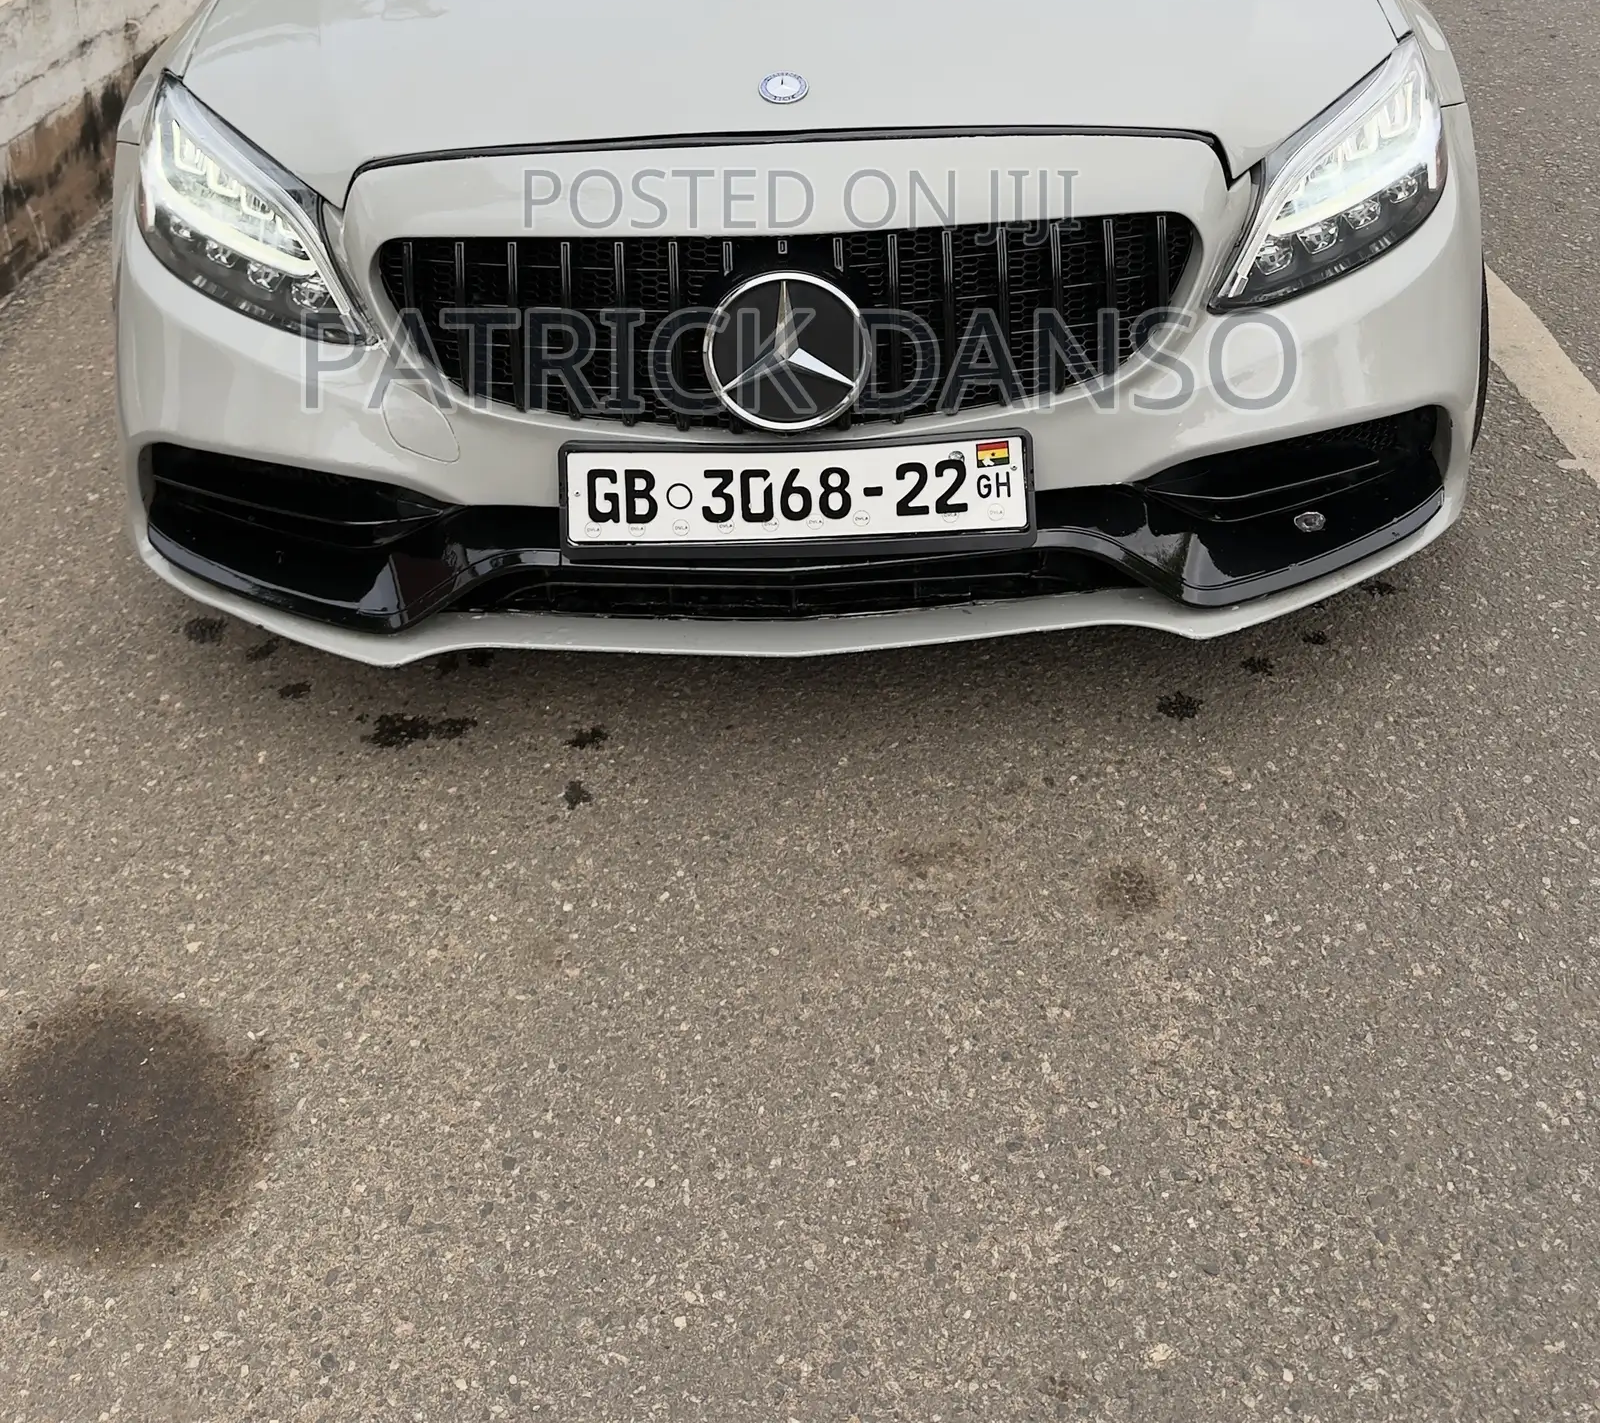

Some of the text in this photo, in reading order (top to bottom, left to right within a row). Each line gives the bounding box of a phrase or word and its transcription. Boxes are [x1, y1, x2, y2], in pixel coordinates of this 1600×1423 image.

[586, 458, 969, 525] GB 3068-22
[976, 471, 1012, 499] GH
